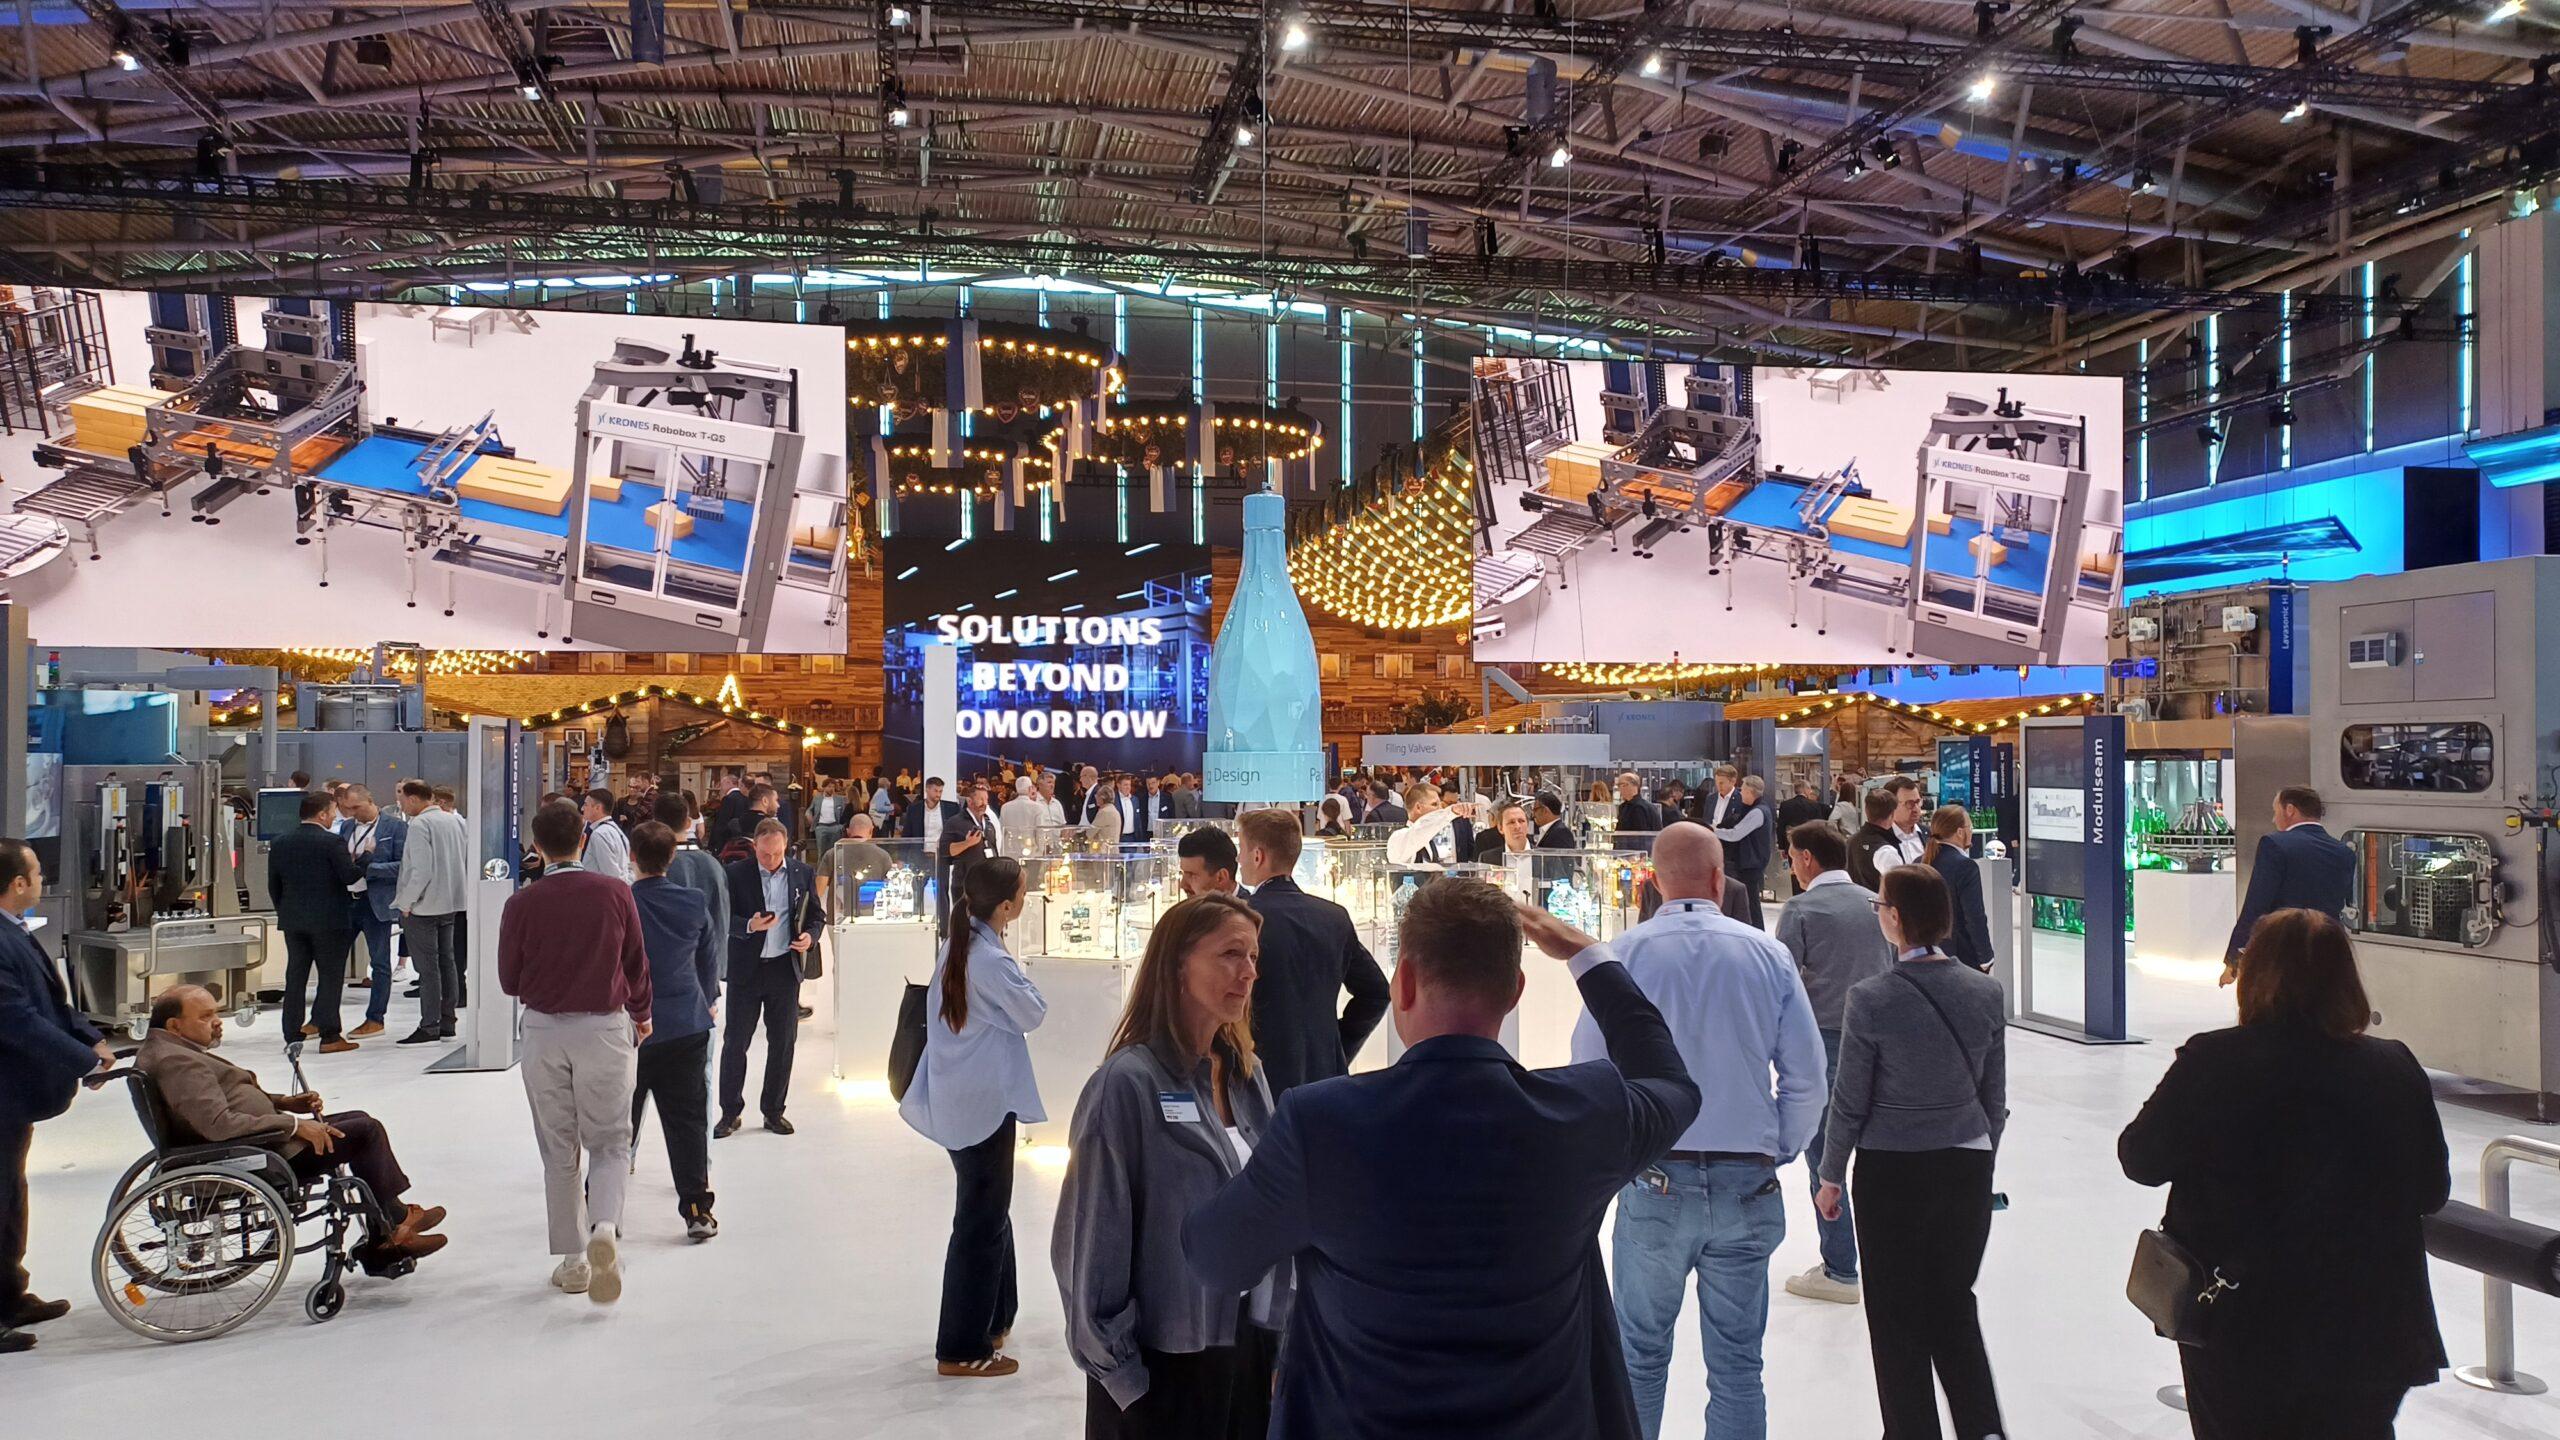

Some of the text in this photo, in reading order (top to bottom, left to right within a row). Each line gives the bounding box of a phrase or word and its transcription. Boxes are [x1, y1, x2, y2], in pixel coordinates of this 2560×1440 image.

[609, 416, 726, 443] KRONES Robobox T-GS
[937, 615, 1162, 645] SOLUTIONS
[972, 662, 1129, 692] BEYOND
[955, 710, 1167, 739] OMORROW
[1408, 744, 1437, 754] Valves
[1214, 768, 1260, 785] Design
[2093, 738, 2103, 844] Modulseam
